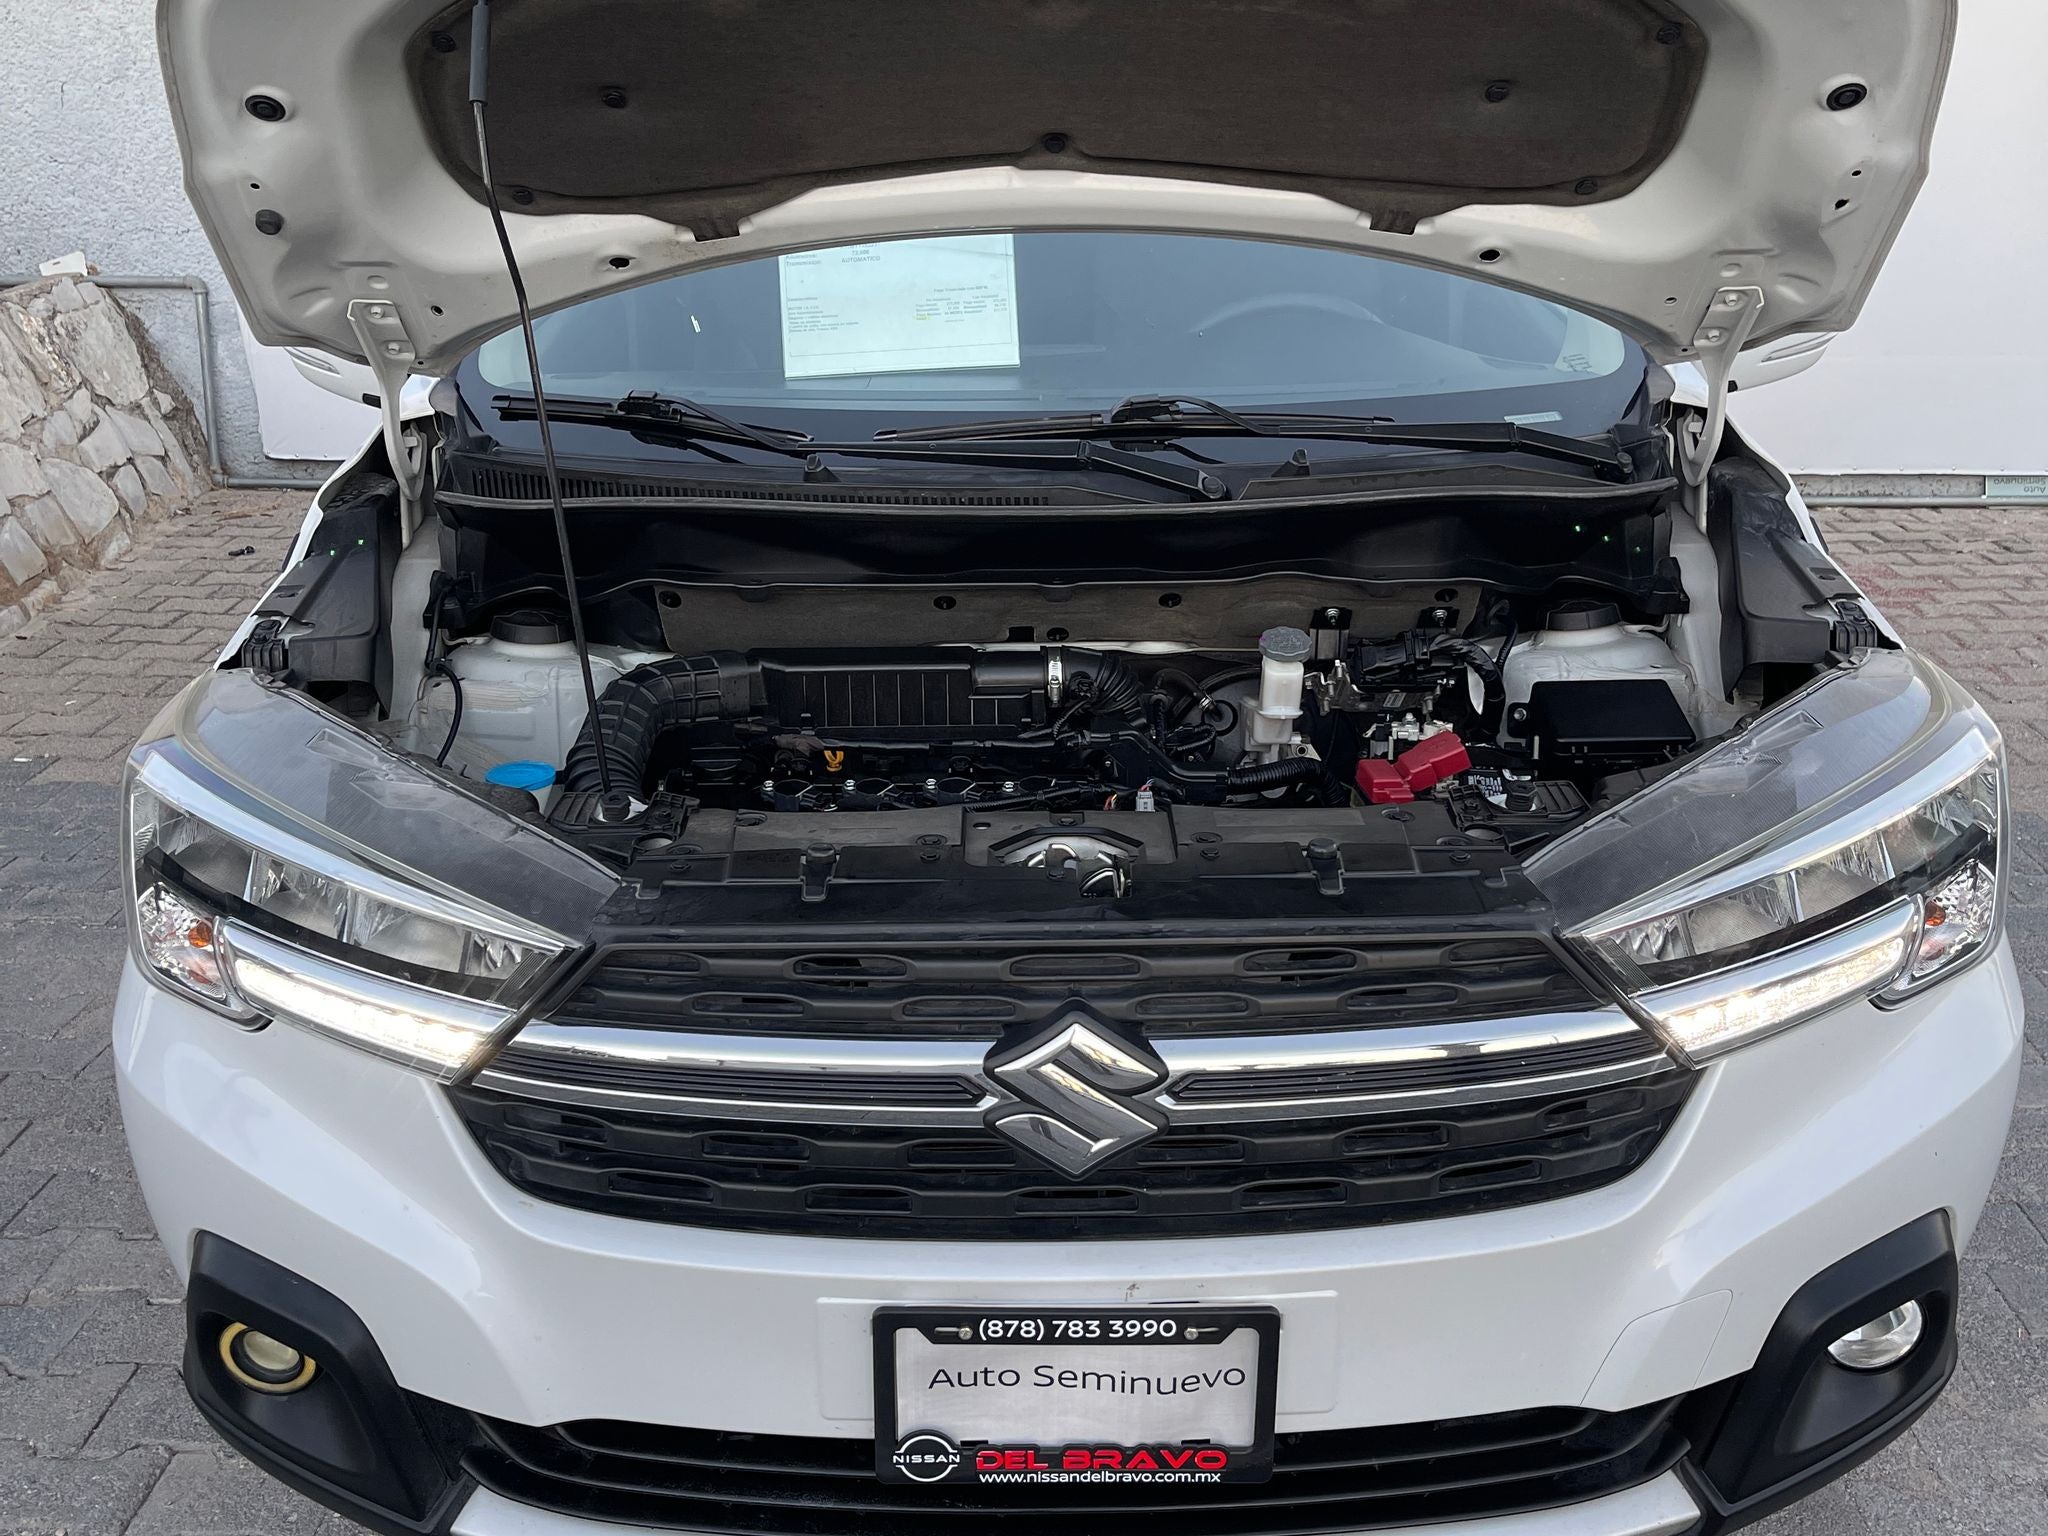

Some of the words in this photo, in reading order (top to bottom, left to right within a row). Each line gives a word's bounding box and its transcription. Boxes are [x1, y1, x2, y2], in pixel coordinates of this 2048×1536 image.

[2023, 486, 2046, 494] Auto
[979, 1318, 1045, 1341] (878)
[1052, 1319, 1101, 1339] 783
[1108, 1319, 1177, 1338] 3990
[928, 1368, 1021, 1389] Auto
[1033, 1365, 1246, 1395] Seminuevo
[893, 1453, 960, 1464] NISSAN
[976, 1450, 1048, 1470] DEL
[1063, 1450, 1227, 1470] BRAVO
[979, 1470, 1222, 1485] www.nissandelbravo.com.mx
